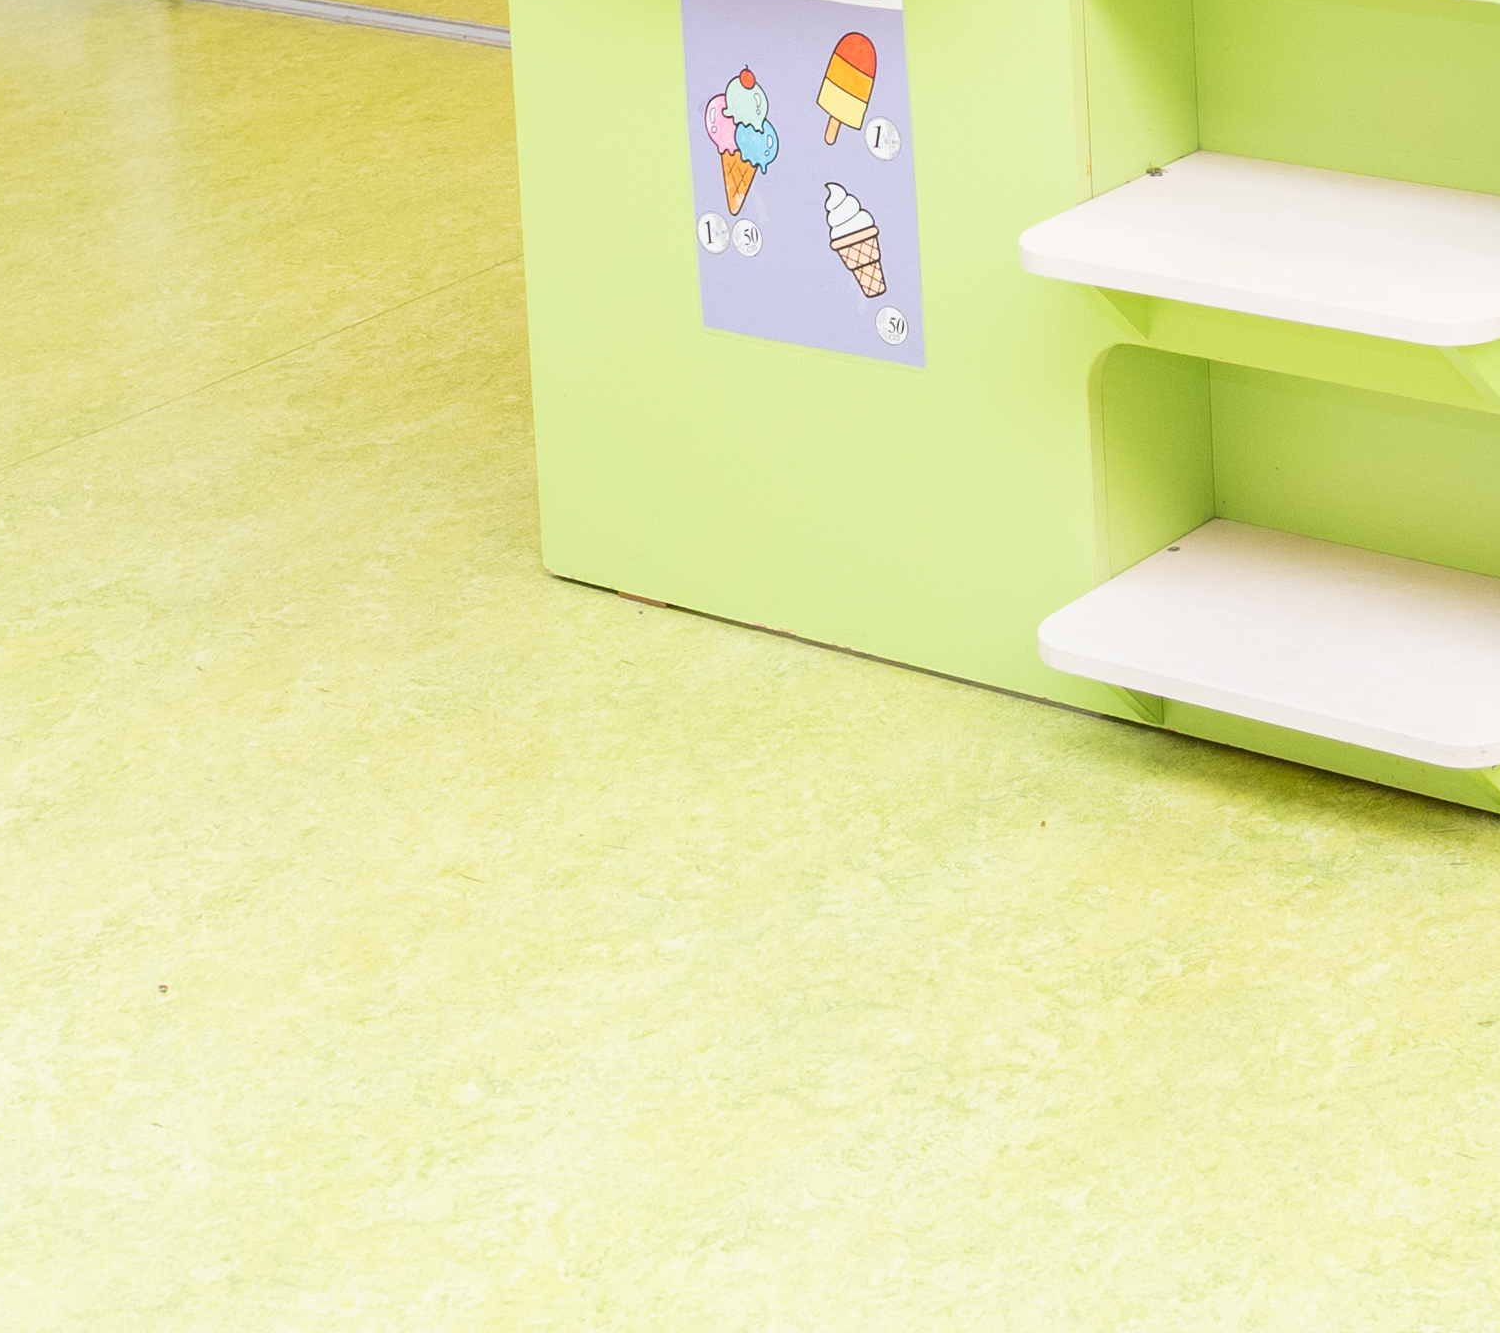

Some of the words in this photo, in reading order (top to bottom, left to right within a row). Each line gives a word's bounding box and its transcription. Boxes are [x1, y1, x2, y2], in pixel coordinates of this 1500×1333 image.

[872, 125, 881, 148] 1
[704, 220, 714, 245] 1
[743, 226, 759, 246] 50
[887, 317, 905, 335] 50
